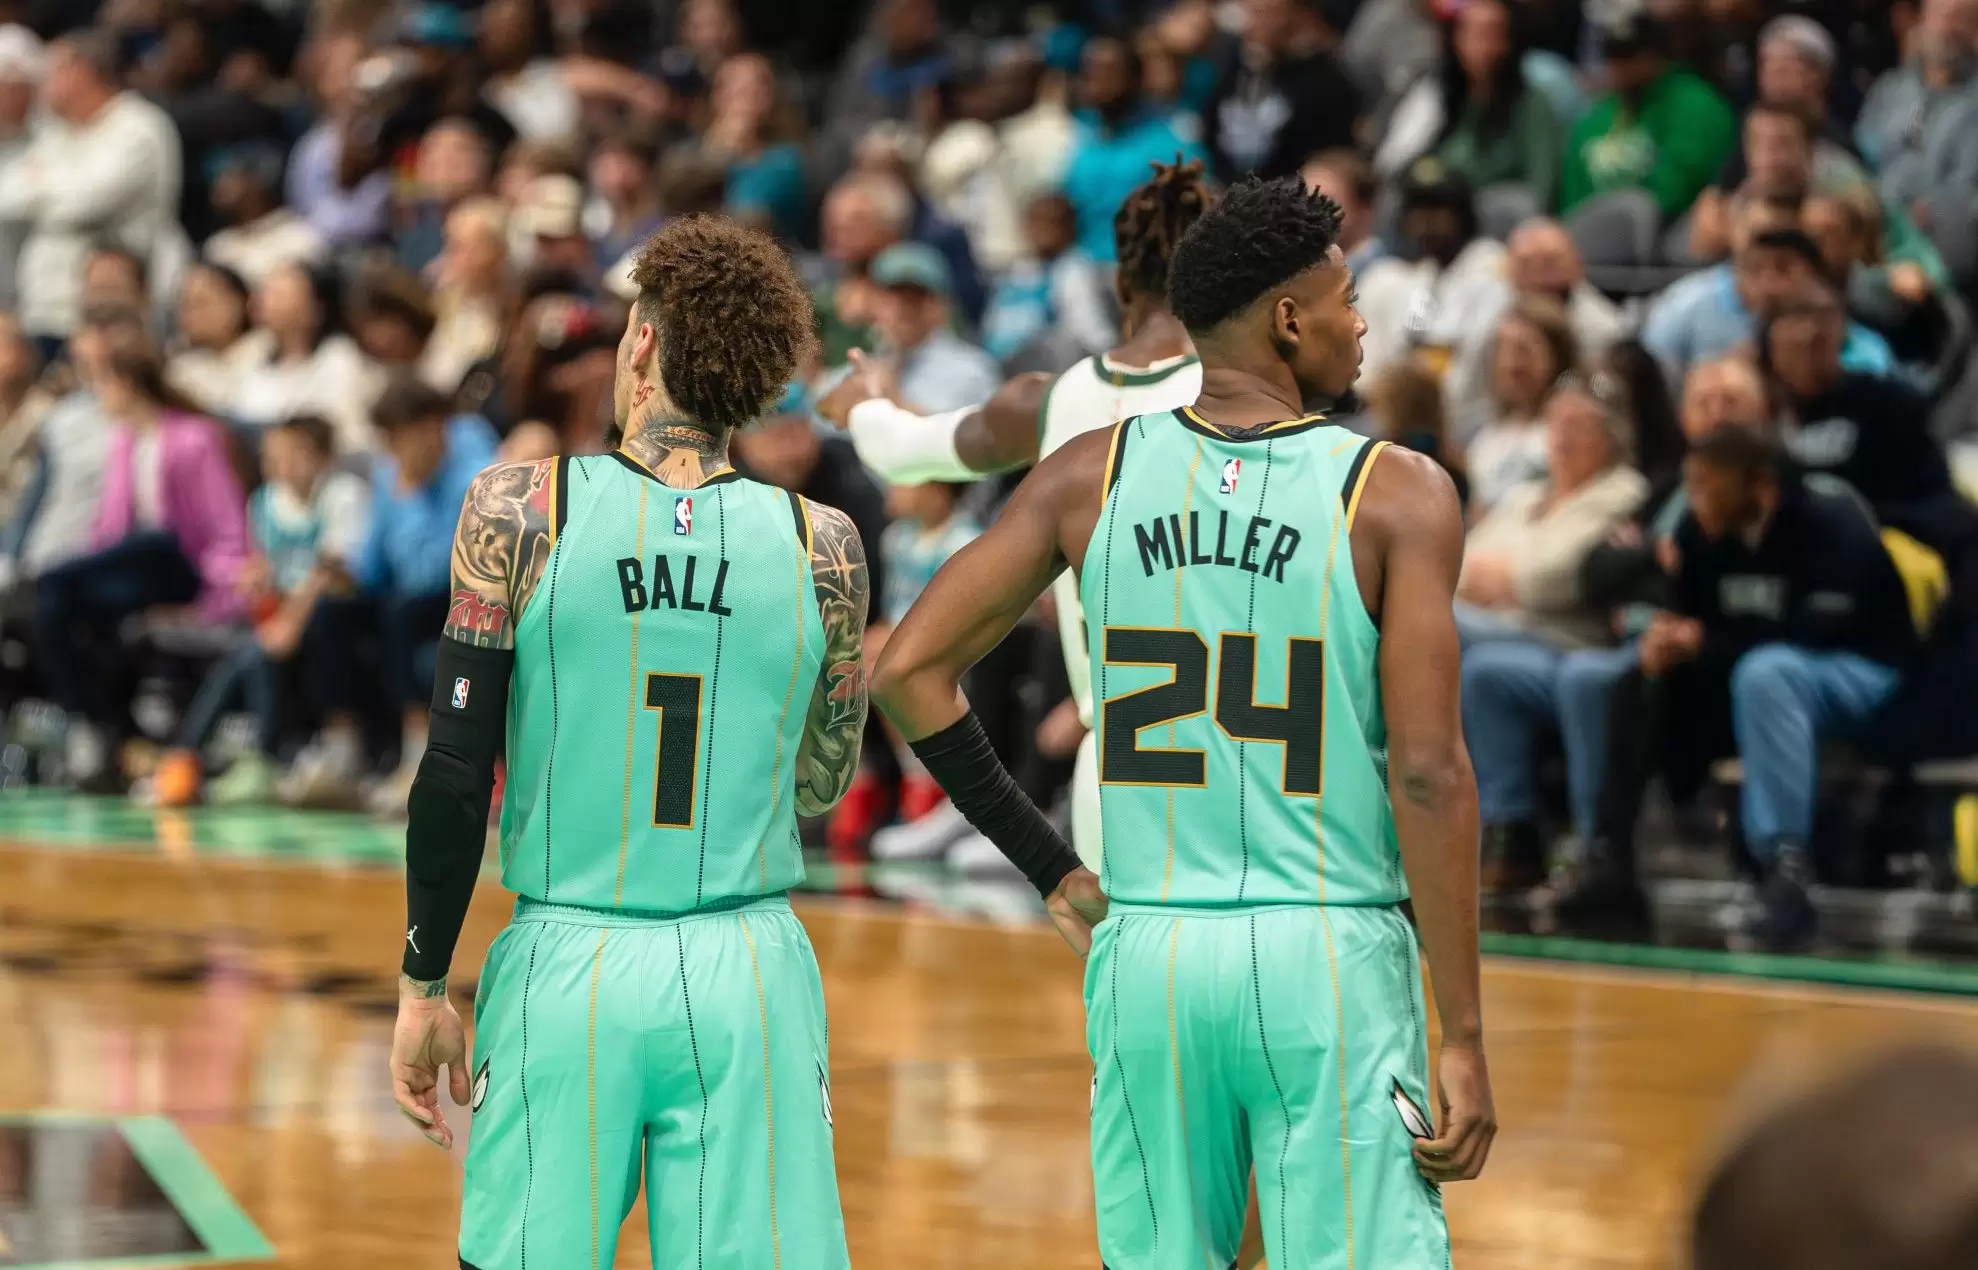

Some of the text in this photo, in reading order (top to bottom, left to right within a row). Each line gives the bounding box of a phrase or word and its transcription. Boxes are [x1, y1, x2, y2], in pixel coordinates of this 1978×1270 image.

[616, 554, 732, 617] BALL
[1133, 510, 1301, 584] MILLER
[643, 671, 704, 830] 1
[1100, 625, 1326, 798] 24
